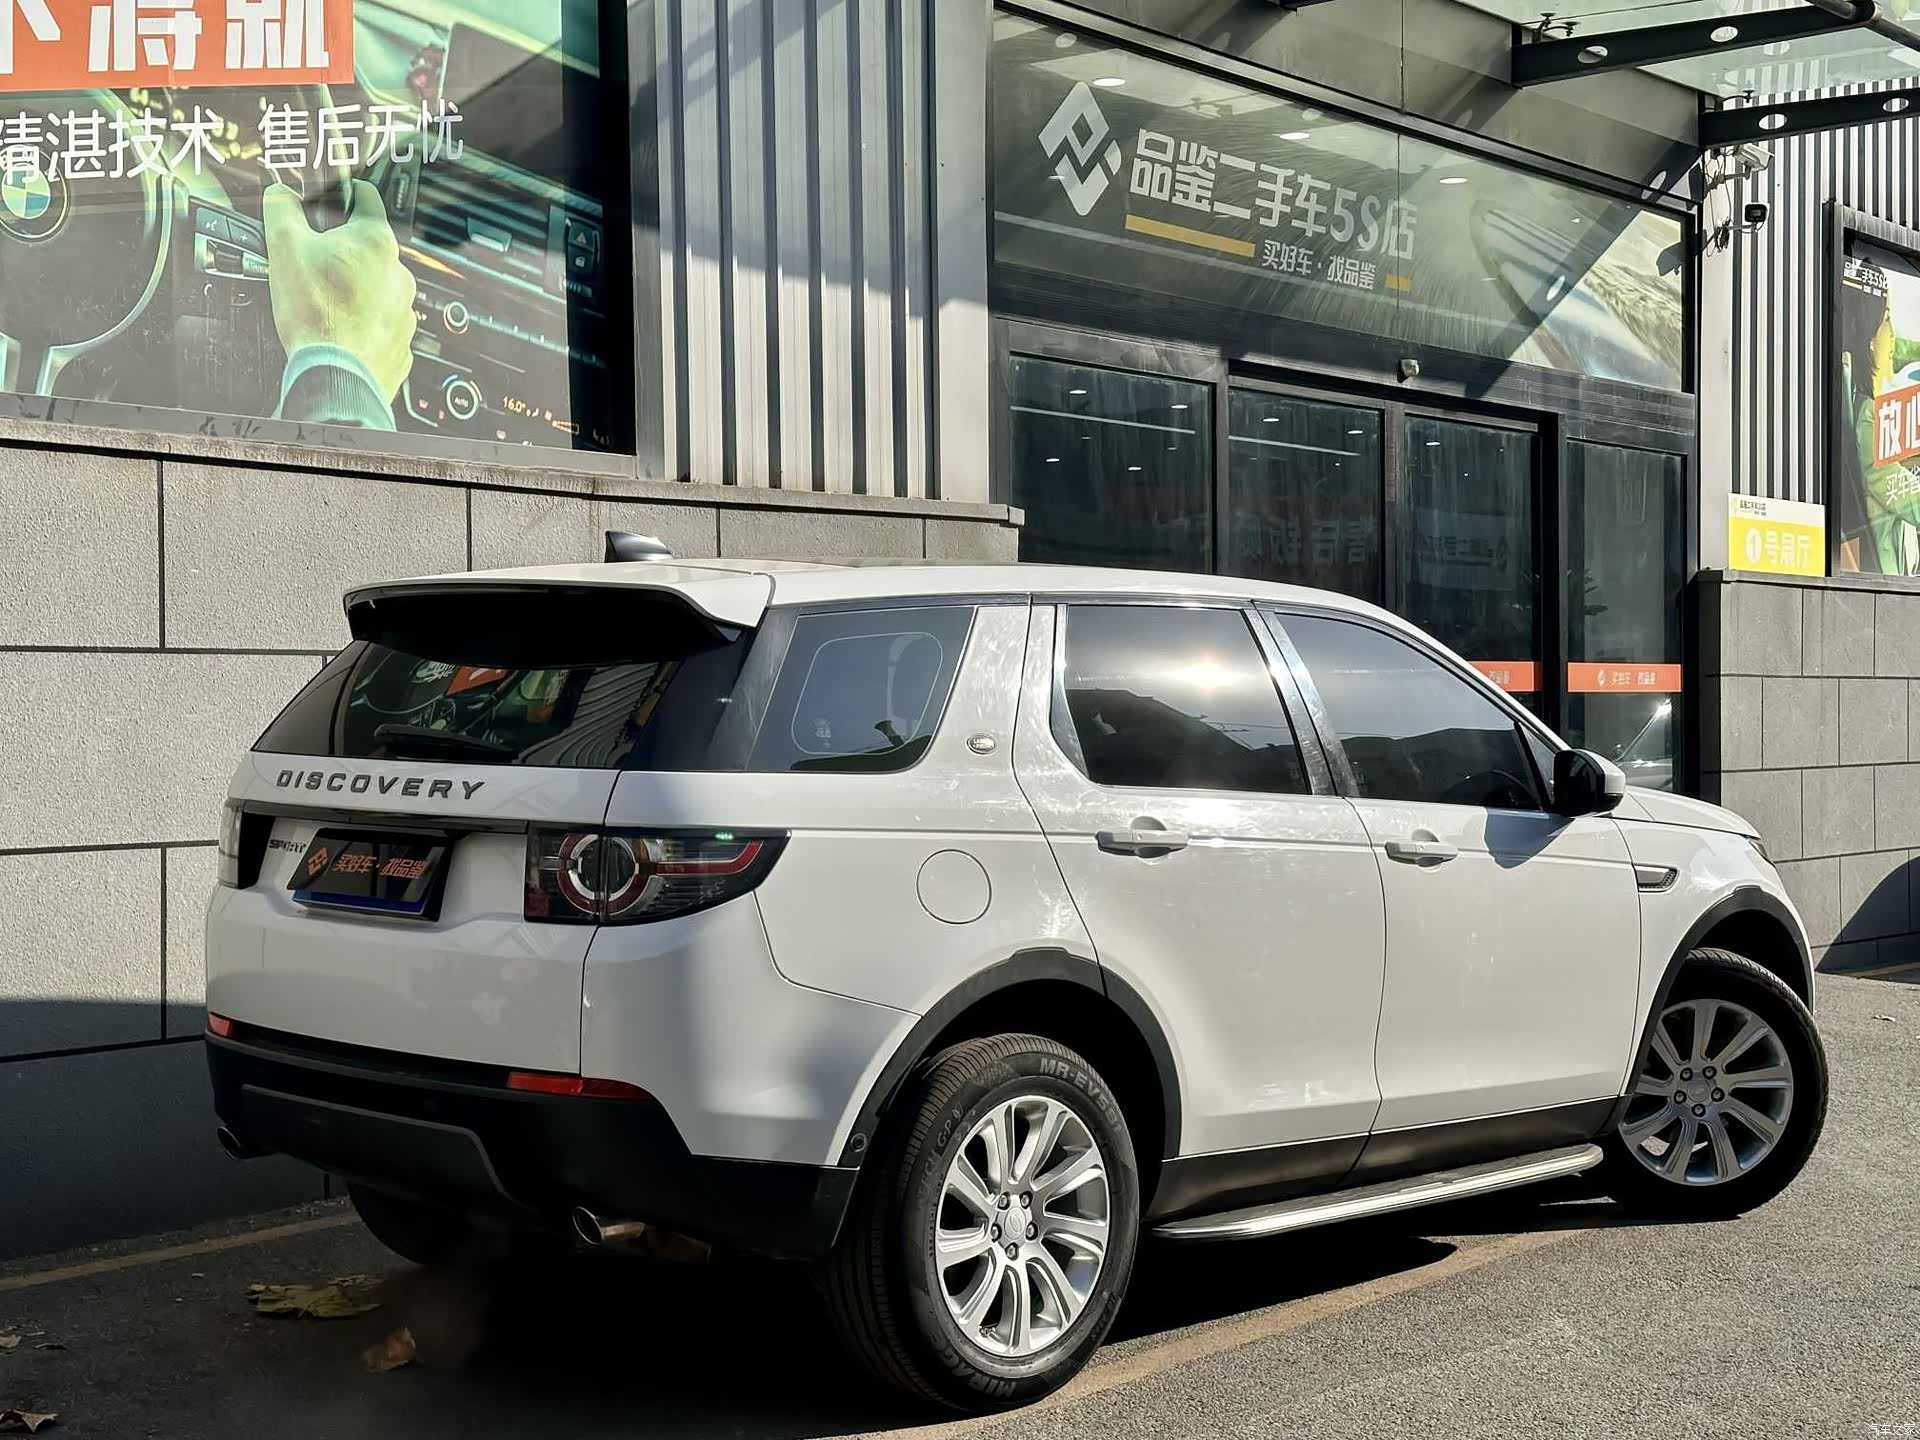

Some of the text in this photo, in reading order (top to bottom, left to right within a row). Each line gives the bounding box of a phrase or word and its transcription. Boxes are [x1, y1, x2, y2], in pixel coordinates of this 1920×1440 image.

[0, 99, 465, 185] 精湛技术 售后无忧
[1130, 127, 1418, 260] 品鉴二手车5S店
[275, 769, 486, 800] DISCOVERY
